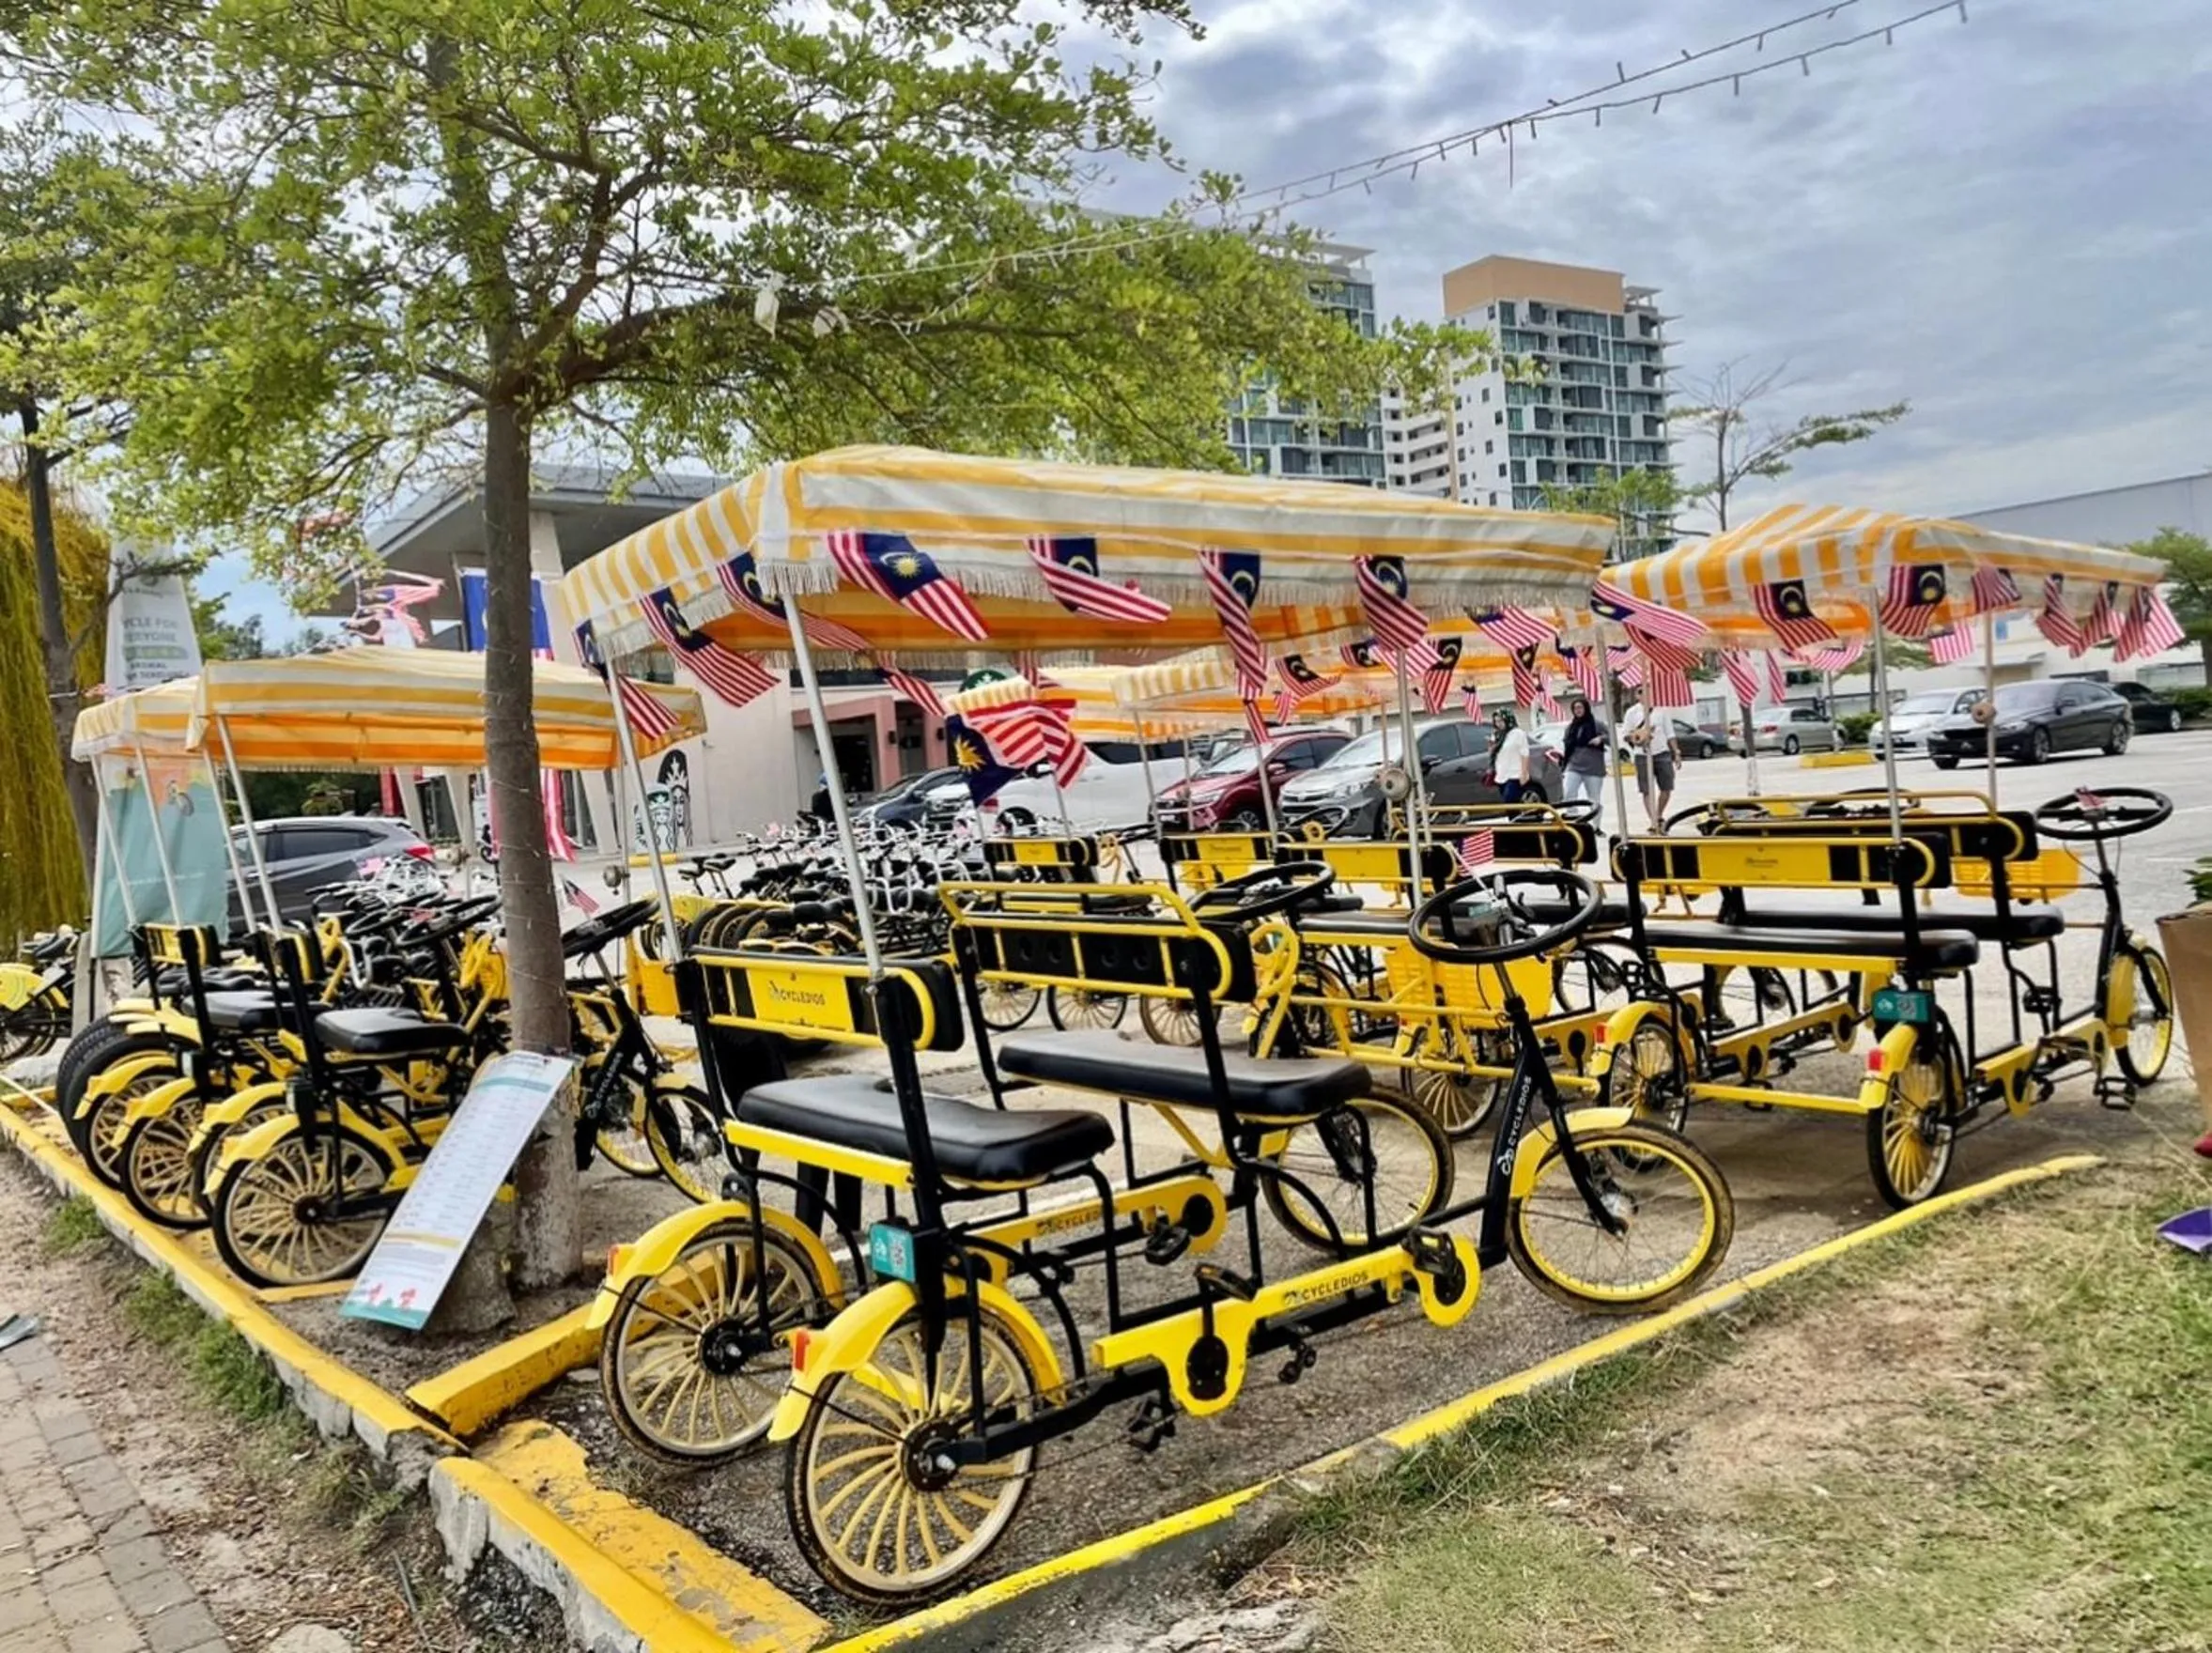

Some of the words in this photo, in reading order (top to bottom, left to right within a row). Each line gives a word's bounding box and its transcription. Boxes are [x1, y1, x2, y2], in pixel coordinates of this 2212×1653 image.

[123, 617, 151, 628] YCLE
[1508, 1075, 1532, 1147] CYCLEDIOS
[1055, 1208, 1101, 1230] CYCLED
[1302, 1271, 1369, 1301] CYCLEDIOS
